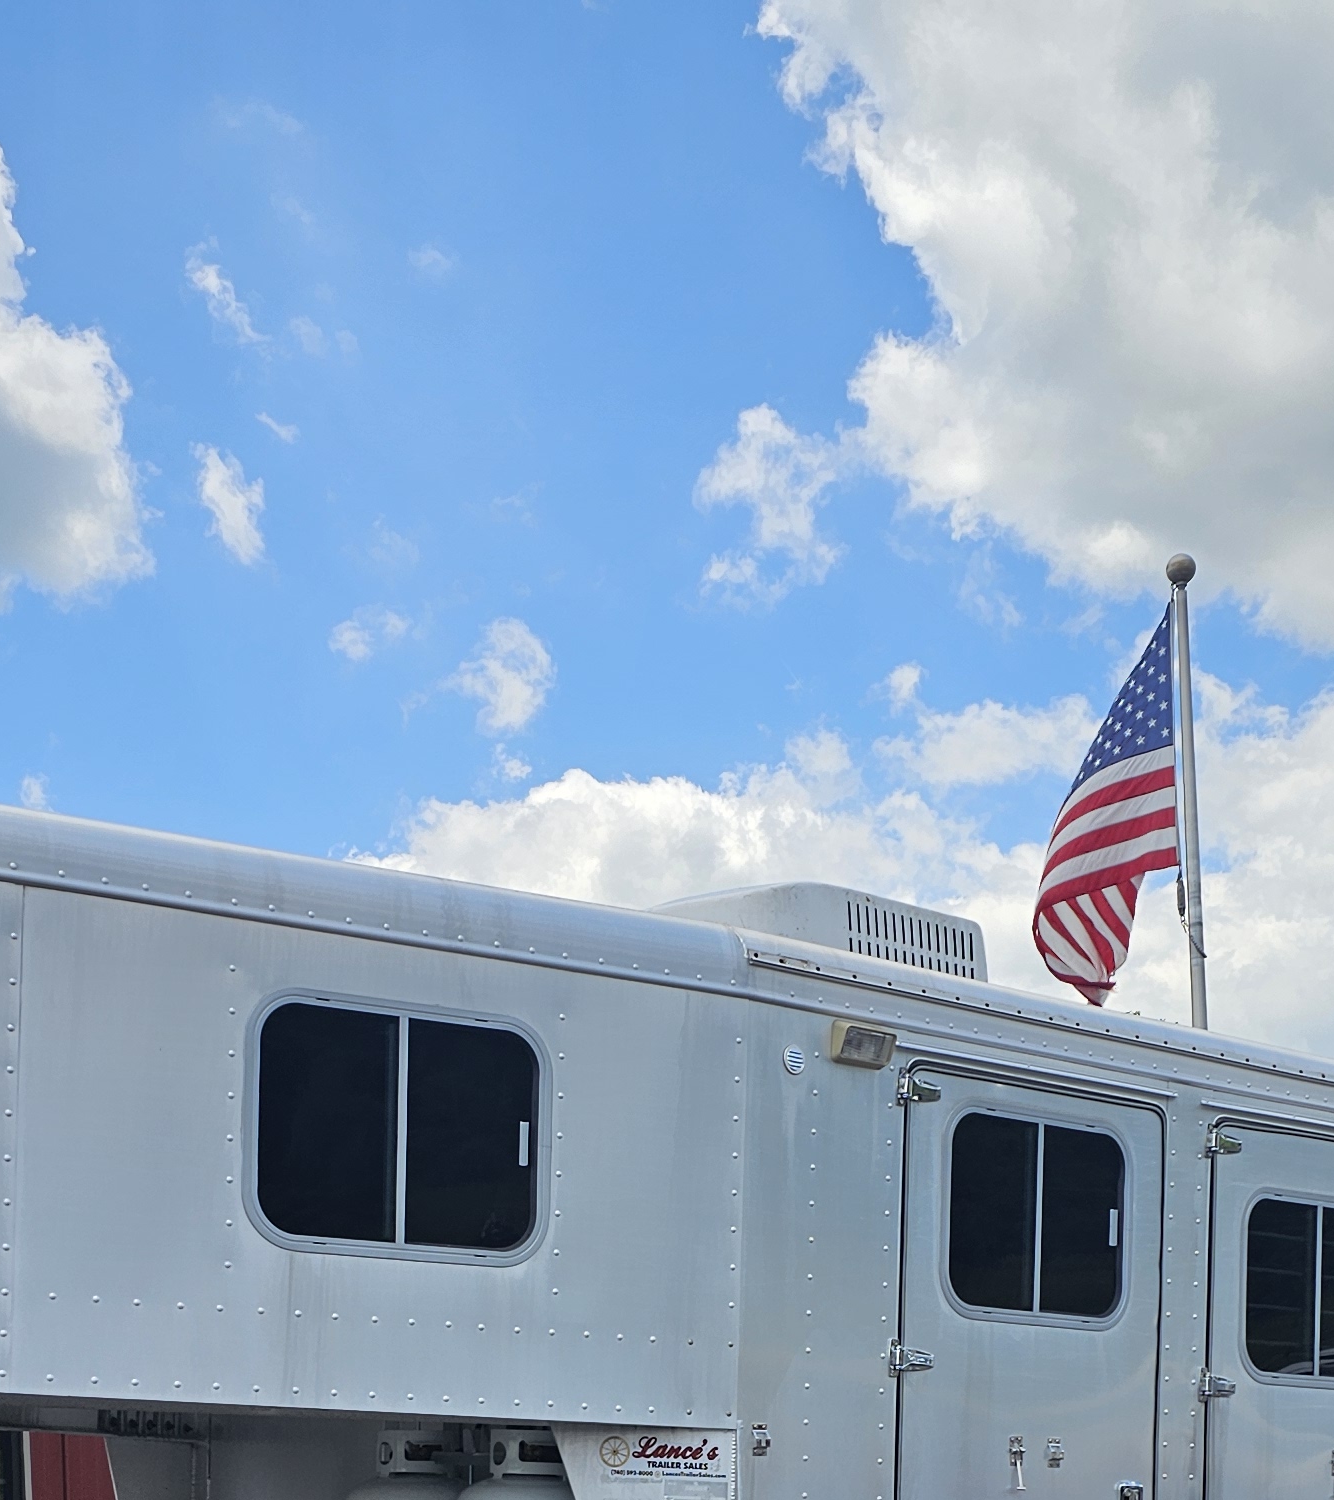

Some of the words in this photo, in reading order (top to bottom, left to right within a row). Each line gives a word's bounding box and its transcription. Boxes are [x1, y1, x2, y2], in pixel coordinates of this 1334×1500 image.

[632, 1436, 719, 1460] Lance's
[647, 1461, 681, 1469] TRAILER
[684, 1462, 708, 1470] SALES
